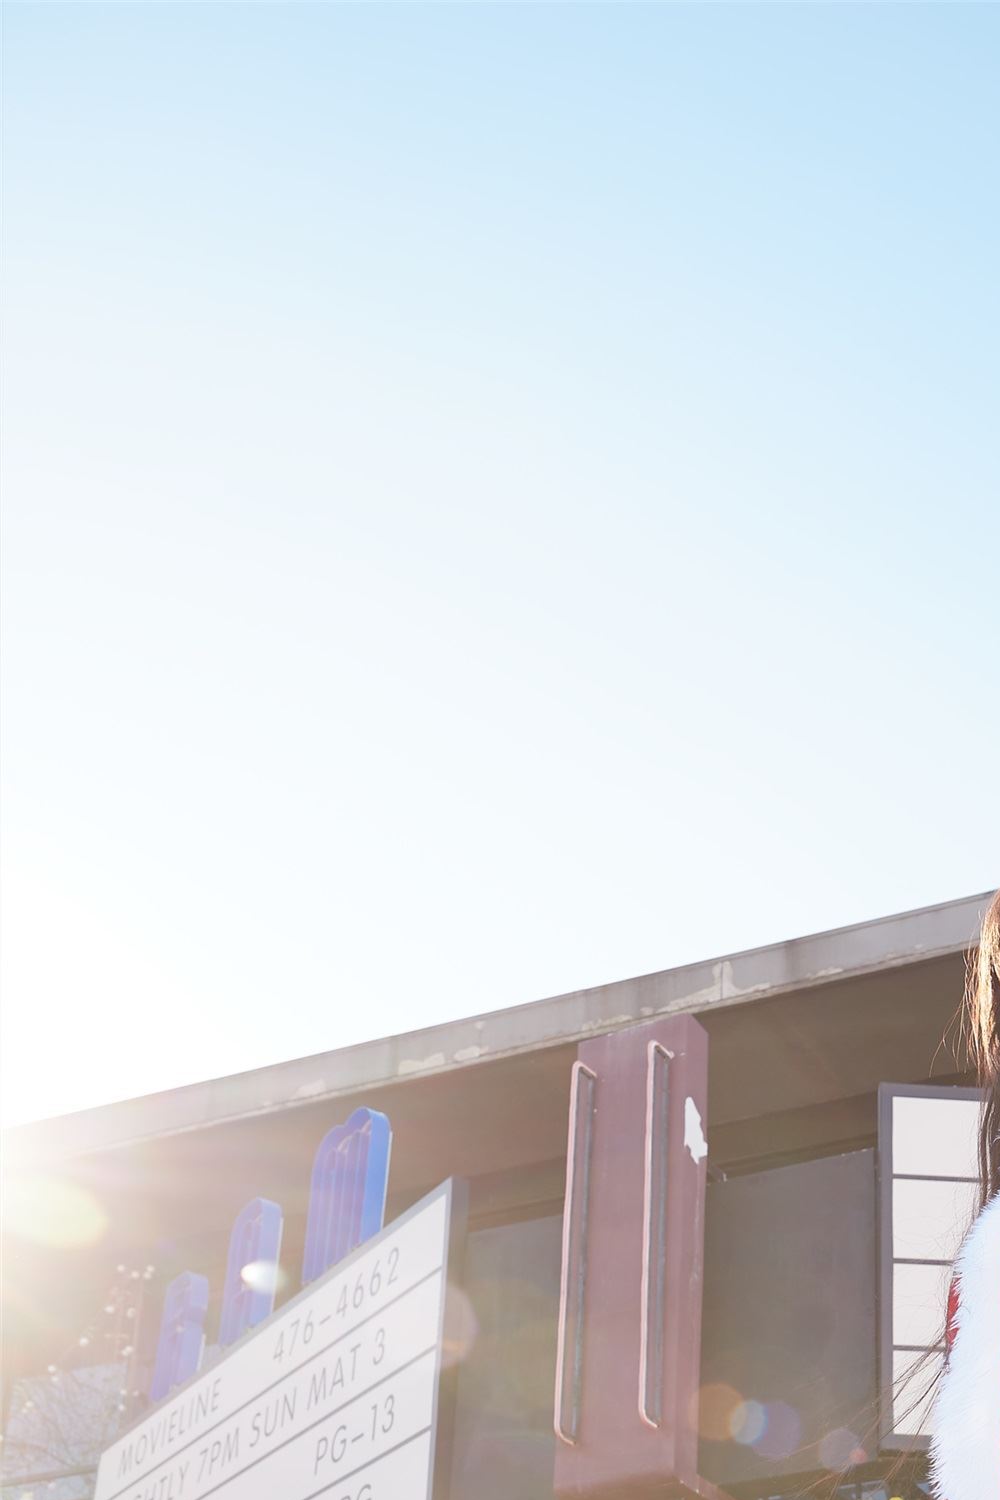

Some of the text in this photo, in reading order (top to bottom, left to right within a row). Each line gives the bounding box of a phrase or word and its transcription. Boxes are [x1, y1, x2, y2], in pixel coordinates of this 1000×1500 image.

[117, 1378, 221, 1479] MOVIELINE
[273, 1247, 400, 1363] 476-4662
[198, 1427, 240, 1482] 7PM
[249, 1386, 297, 1447] SUN
[306, 1343, 361, 1411] MAT
[372, 1328, 385, 1366] 3
[314, 1394, 395, 1476] PG-13
